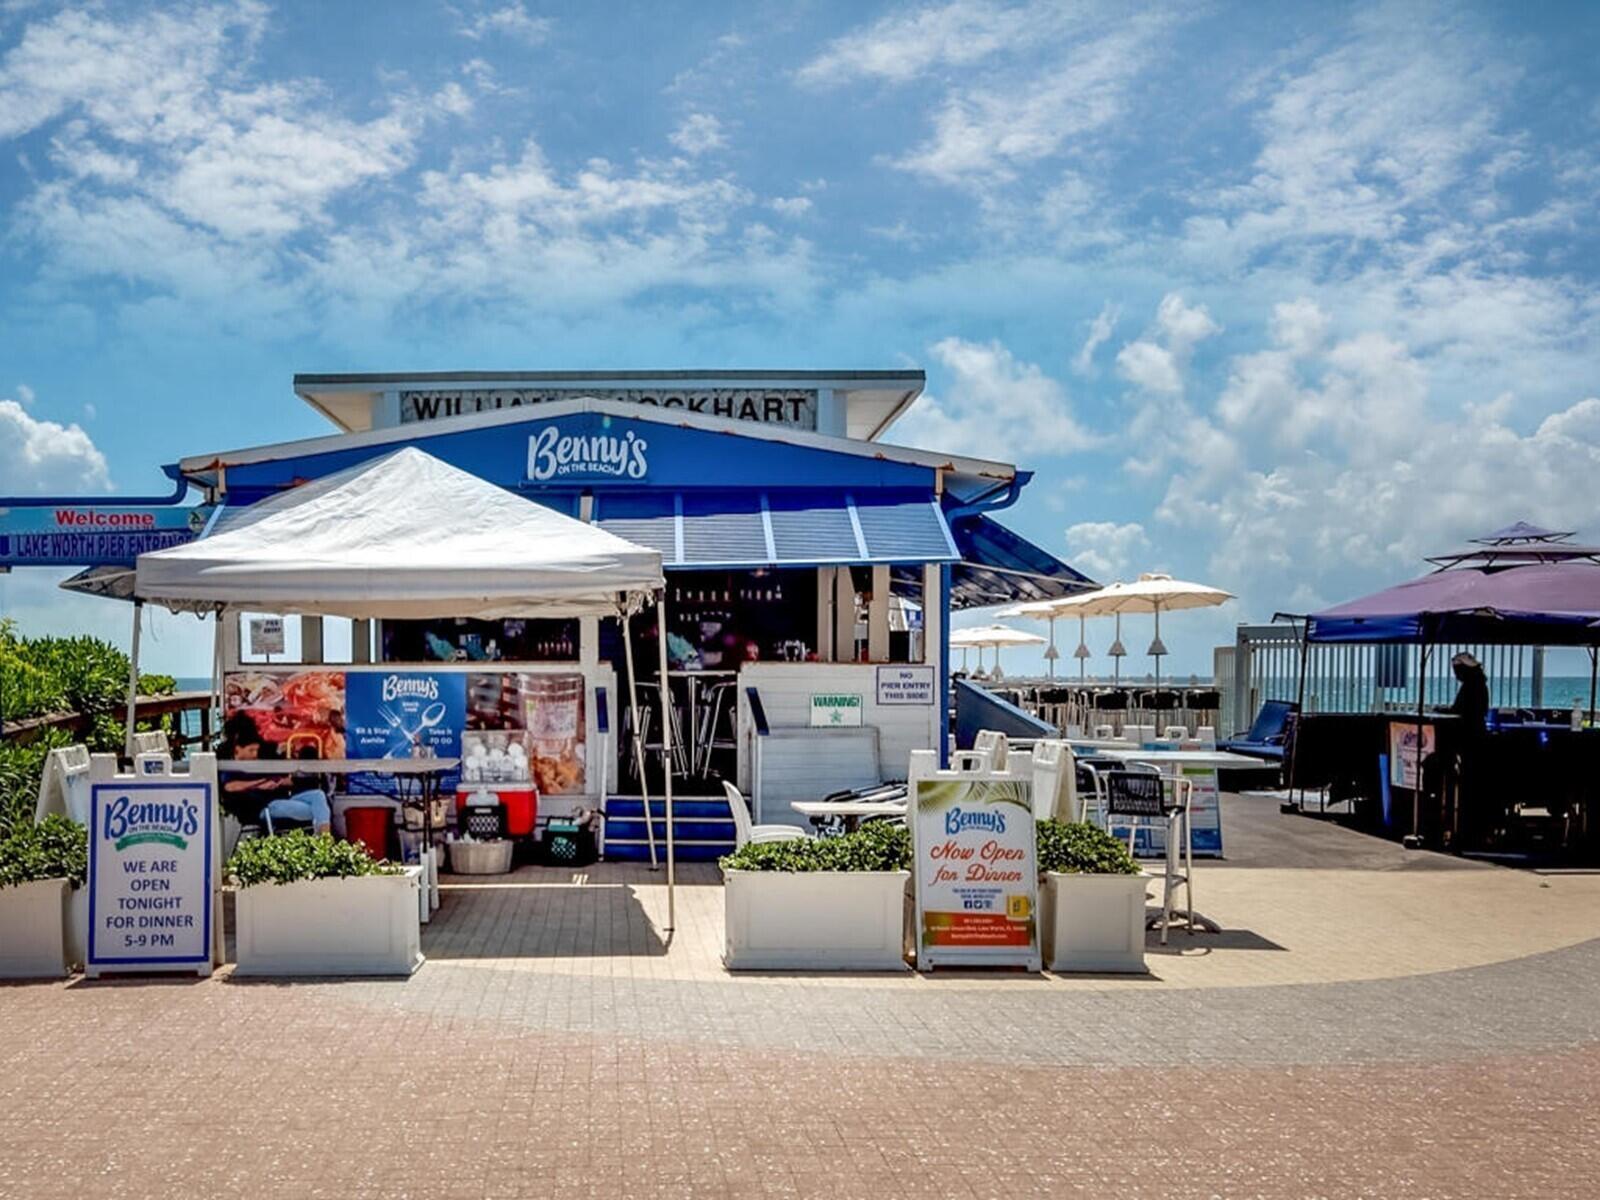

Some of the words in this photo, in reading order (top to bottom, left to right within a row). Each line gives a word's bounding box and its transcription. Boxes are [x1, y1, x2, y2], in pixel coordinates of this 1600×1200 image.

[617, 396, 806, 422] KHART
[527, 426, 648, 480] Benny's
[557, 465, 570, 475] ON
[571, 463, 587, 473] THE
[588, 463, 615, 474] BEACH
[55, 510, 154, 526] Welcome
[17, 534, 49, 557] LAKE
[51, 533, 95, 557] WORTH
[98, 533, 124, 557] PIER
[382, 674, 439, 702] Benny's
[881, 682, 901, 690] PIER
[903, 682, 931, 690] ENTRY
[813, 696, 860, 707] WARNING!
[104, 796, 198, 840] Benny's
[946, 807, 1006, 835] Benny's
[930, 840, 976, 860] Now
[980, 840, 1026, 865] Open
[123, 861, 146, 873] WE
[150, 860, 178, 873] ARE
[928, 864, 959, 887] for
[965, 863, 1024, 882] Dinner
[130, 879, 170, 892] OPEN
[118, 897, 183, 910] TONIGHT
[106, 916, 135, 928] FOR
[139, 915, 194, 928] DINNER
[124, 934, 147, 947] 5-9
[151, 934, 175, 947] PM
